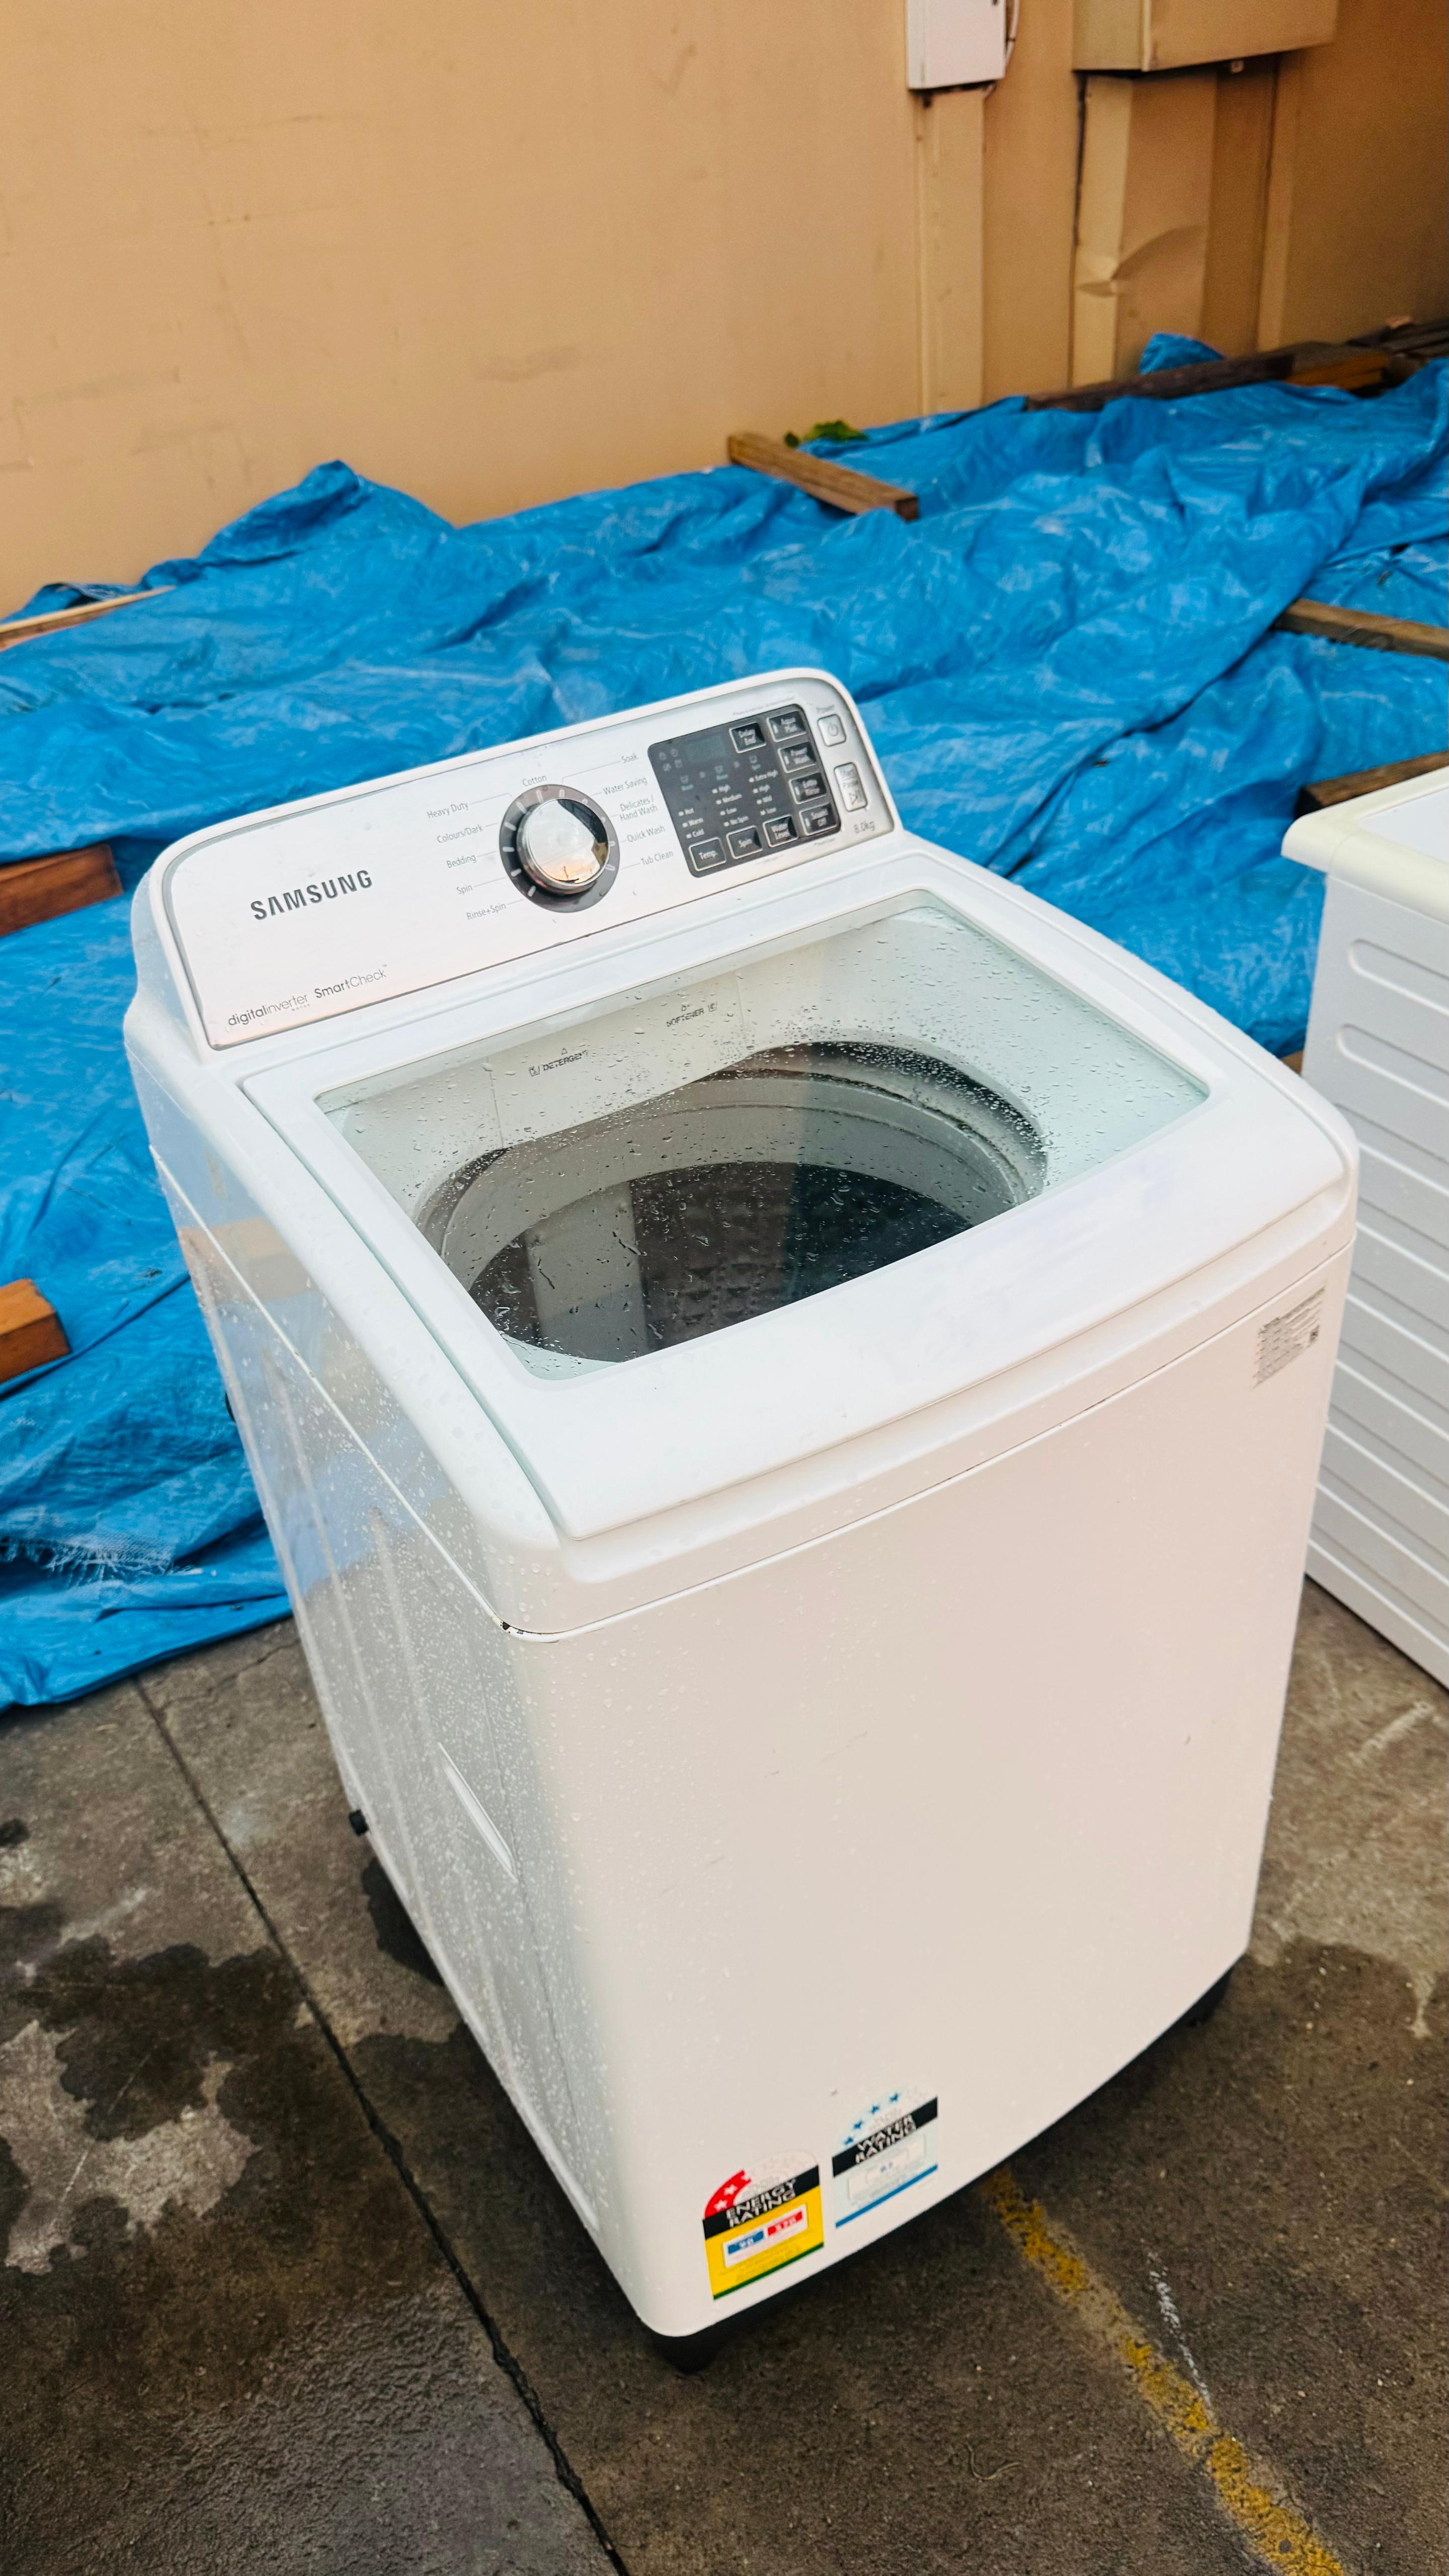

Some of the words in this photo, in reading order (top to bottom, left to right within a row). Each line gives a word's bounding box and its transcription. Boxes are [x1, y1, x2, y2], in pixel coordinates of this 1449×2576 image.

[621, 753, 638, 763] Soak
[523, 775, 547, 787] Cotton
[603, 783, 624, 795] Water
[625, 777, 648, 789] Saving
[427, 806, 450, 819] Heavy
[451, 801, 468, 813] Duty
[620, 797, 651, 812] Delicates
[619, 809, 639, 822] Hand
[639, 805, 658, 816] Wash
[437, 824, 483, 843] Colours/Dark
[627, 831, 646, 843] Quick
[647, 825, 666, 836] Wash
[692, 829, 704, 837] Cold
[739, 838, 753, 848] Spin
[446, 855, 476, 868] Bedding
[641, 855, 655, 866] Tub
[655, 850, 674, 862] Clean
[251, 870, 372, 920] SAMSUNG
[456, 884, 473, 895] Spin
[466, 903, 506, 920] Rinse+Spin
[726, 2179, 796, 2219] ENERGY
[729, 2189, 795, 2227] RATING
